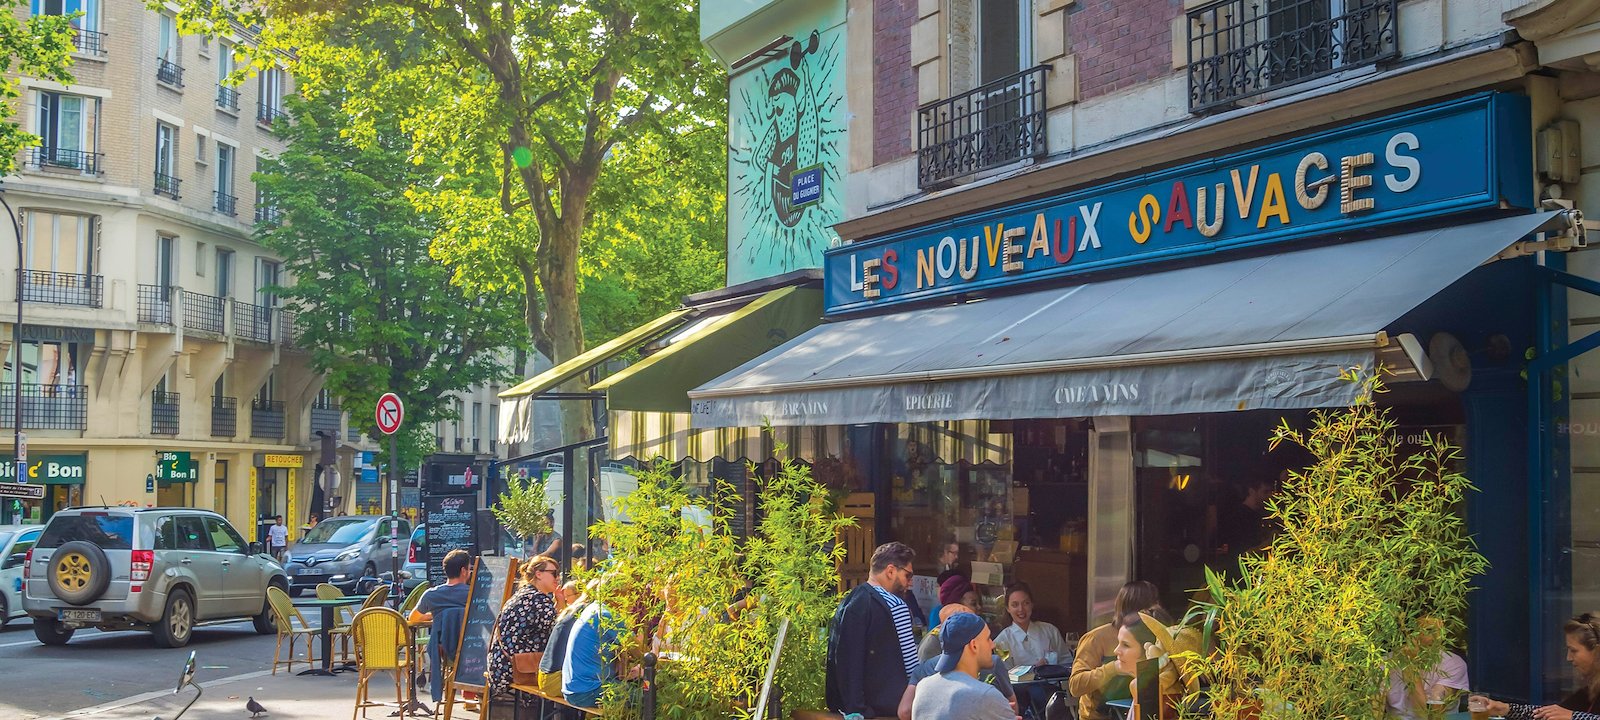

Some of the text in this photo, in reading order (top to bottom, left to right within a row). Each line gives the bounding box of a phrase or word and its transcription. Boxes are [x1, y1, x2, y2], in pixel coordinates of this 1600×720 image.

[797, 173, 815, 187] PLACE
[792, 185, 820, 201] DU GUIGNIER
[850, 131, 1421, 299] LES NOUVEAUX SAUVAGES
[1102, 383, 1139, 401] VINS
[782, 401, 800, 416] BAR
[163, 452, 178, 461] Bio
[266, 455, 303, 464] RETOUCHES
[47, 462, 83, 478] Bon
[170, 470, 187, 478] Bon
